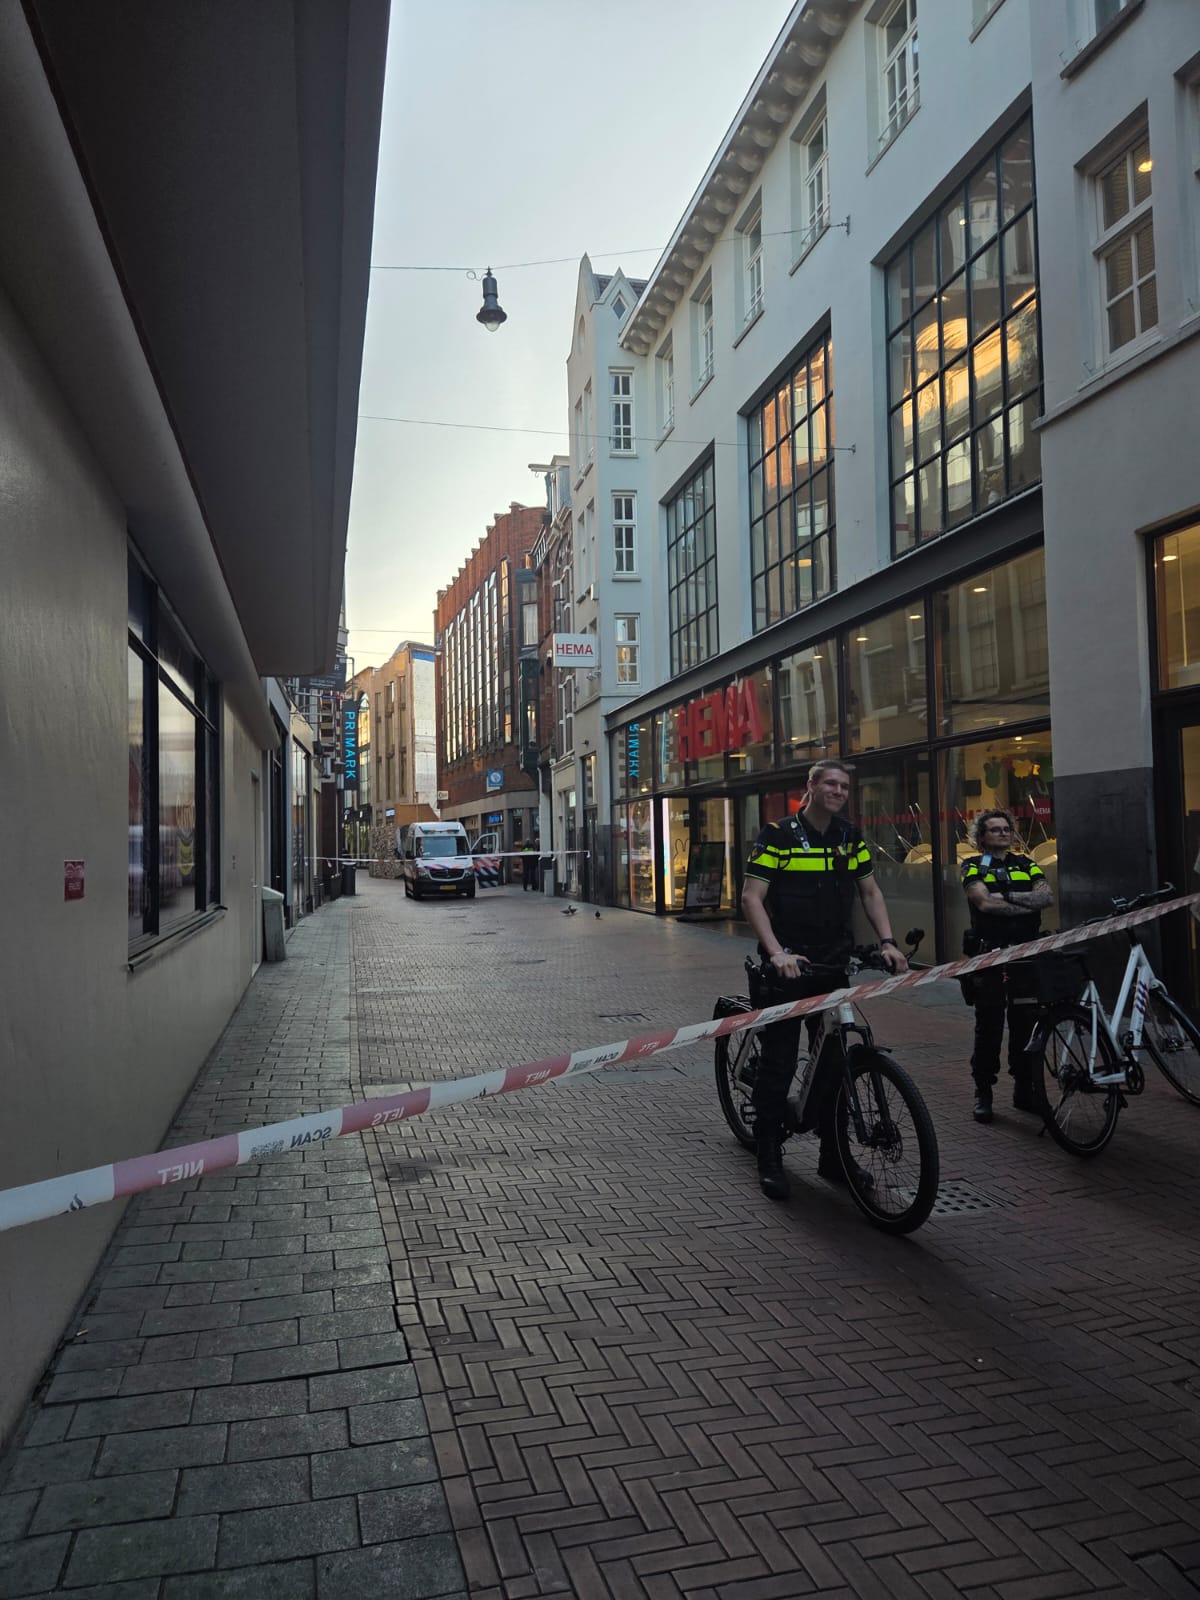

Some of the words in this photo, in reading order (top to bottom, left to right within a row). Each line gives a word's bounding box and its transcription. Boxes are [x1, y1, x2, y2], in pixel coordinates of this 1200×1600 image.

[556, 643, 593, 655] HEMA
[345, 711, 356, 778] PRIMARK
[679, 679, 762, 763] HEMA
